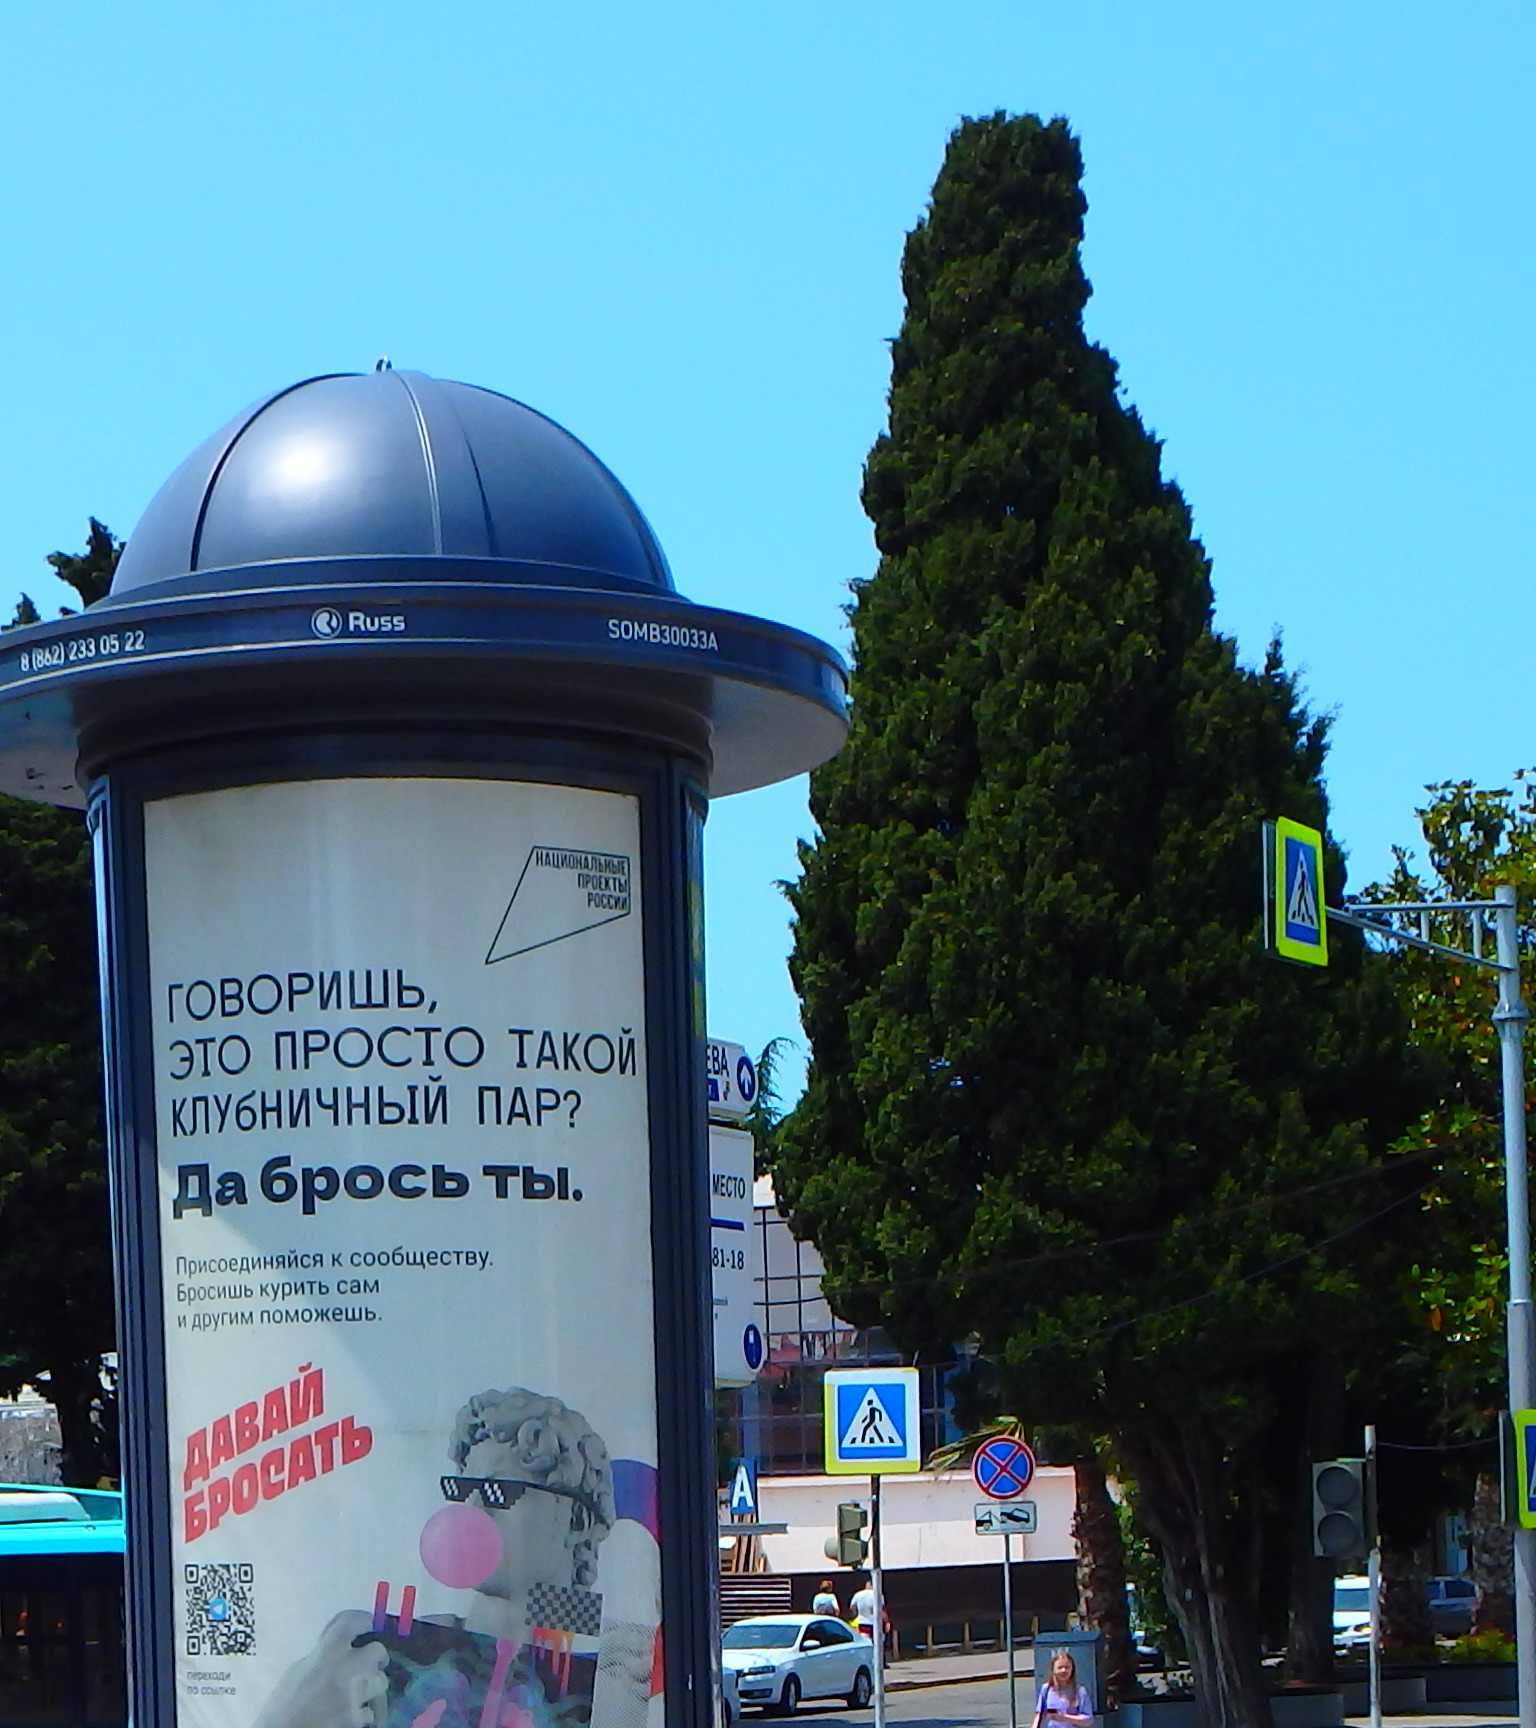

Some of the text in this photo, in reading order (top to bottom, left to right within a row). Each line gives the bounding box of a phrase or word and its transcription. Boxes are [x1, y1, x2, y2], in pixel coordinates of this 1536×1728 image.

[348, 611, 405, 632] Russ
[607, 618, 719, 651] SOMB30033A
[20, 630, 145, 672] 8 (862) 233 05 22
[535, 850, 627, 876] НАЦИОНАЛЬНЫЕ
[577, 873, 628, 893] ПРОЕКТЫ
[587, 892, 628, 911] РОССИИ
[167, 969, 439, 1023] ГОВОРИШЬ,
[169, 1026, 637, 1080] ЭТО ПРОСТО ТАКОЙ
[477, 1084, 582, 1129] ПАР?
[172, 1155, 583, 1220] Да брось ты.
[176, 1246, 494, 1277] Присоединяйся к сообществу.
[176, 1277, 380, 1304] Бросишь курить сам
[177, 1305, 384, 1333] и другим поможешь.
[183, 1361, 325, 1492] ДАВАЙ
[183, 1414, 374, 1544] БРОСАТЬ
